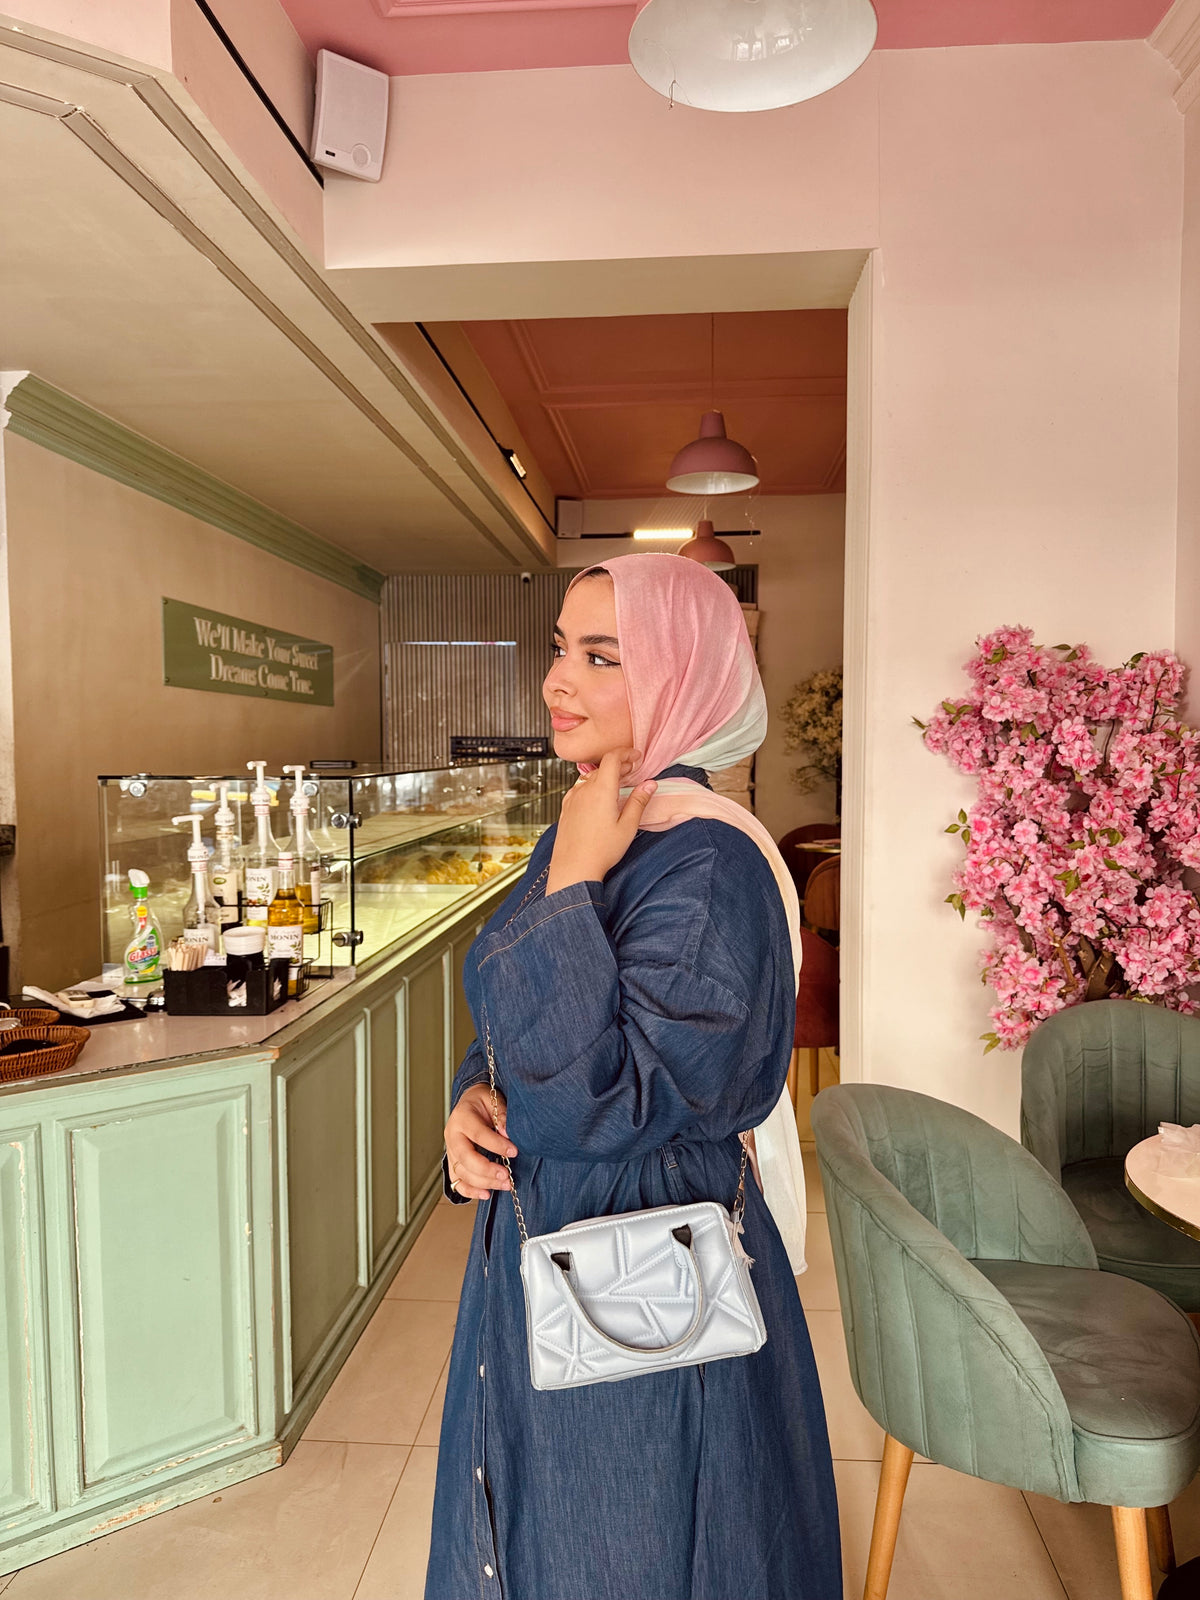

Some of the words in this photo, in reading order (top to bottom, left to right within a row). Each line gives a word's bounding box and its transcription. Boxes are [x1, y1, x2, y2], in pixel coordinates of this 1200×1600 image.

[193, 616, 232, 651] We'll
[232, 627, 265, 659] Make
[265, 636, 291, 665] Your
[291, 645, 320, 671] Sweet
[209, 653, 257, 687] Dreams
[257, 664, 289, 691] Come
